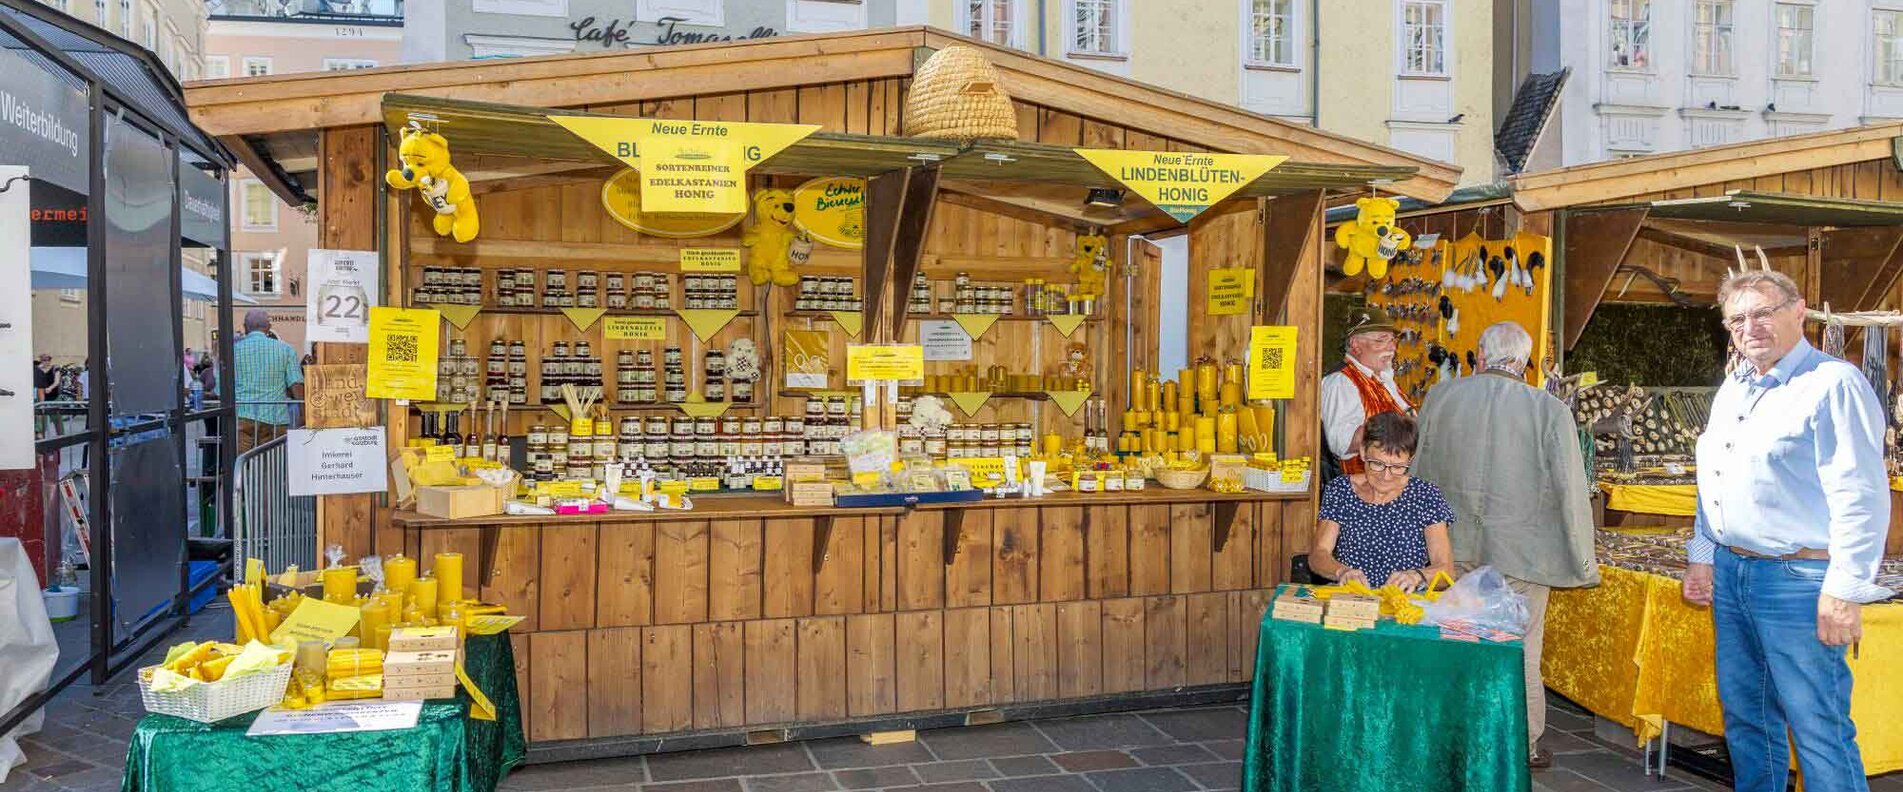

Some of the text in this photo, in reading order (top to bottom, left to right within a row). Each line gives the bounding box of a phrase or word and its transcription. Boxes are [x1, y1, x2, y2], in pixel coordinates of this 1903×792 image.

[571, 17, 635, 47] Café
[0, 90, 78, 157] Weiterbildung
[651, 122, 728, 137] Neue Ernte
[1153, 153, 1214, 167] Neue Ernte
[655, 163, 731, 173] SORTENREINER
[1121, 166, 1246, 184] LINDENBLÜTEN-
[649, 178, 738, 188] EDELKASTANIEN
[674, 190, 715, 199] HONIG
[1158, 187, 1208, 202] HONIG
[325, 294, 360, 318] 22
[321, 450, 353, 459] Imkerei
[320, 461, 354, 470] Gerhard
[311, 471, 364, 481] Hinterhauser
